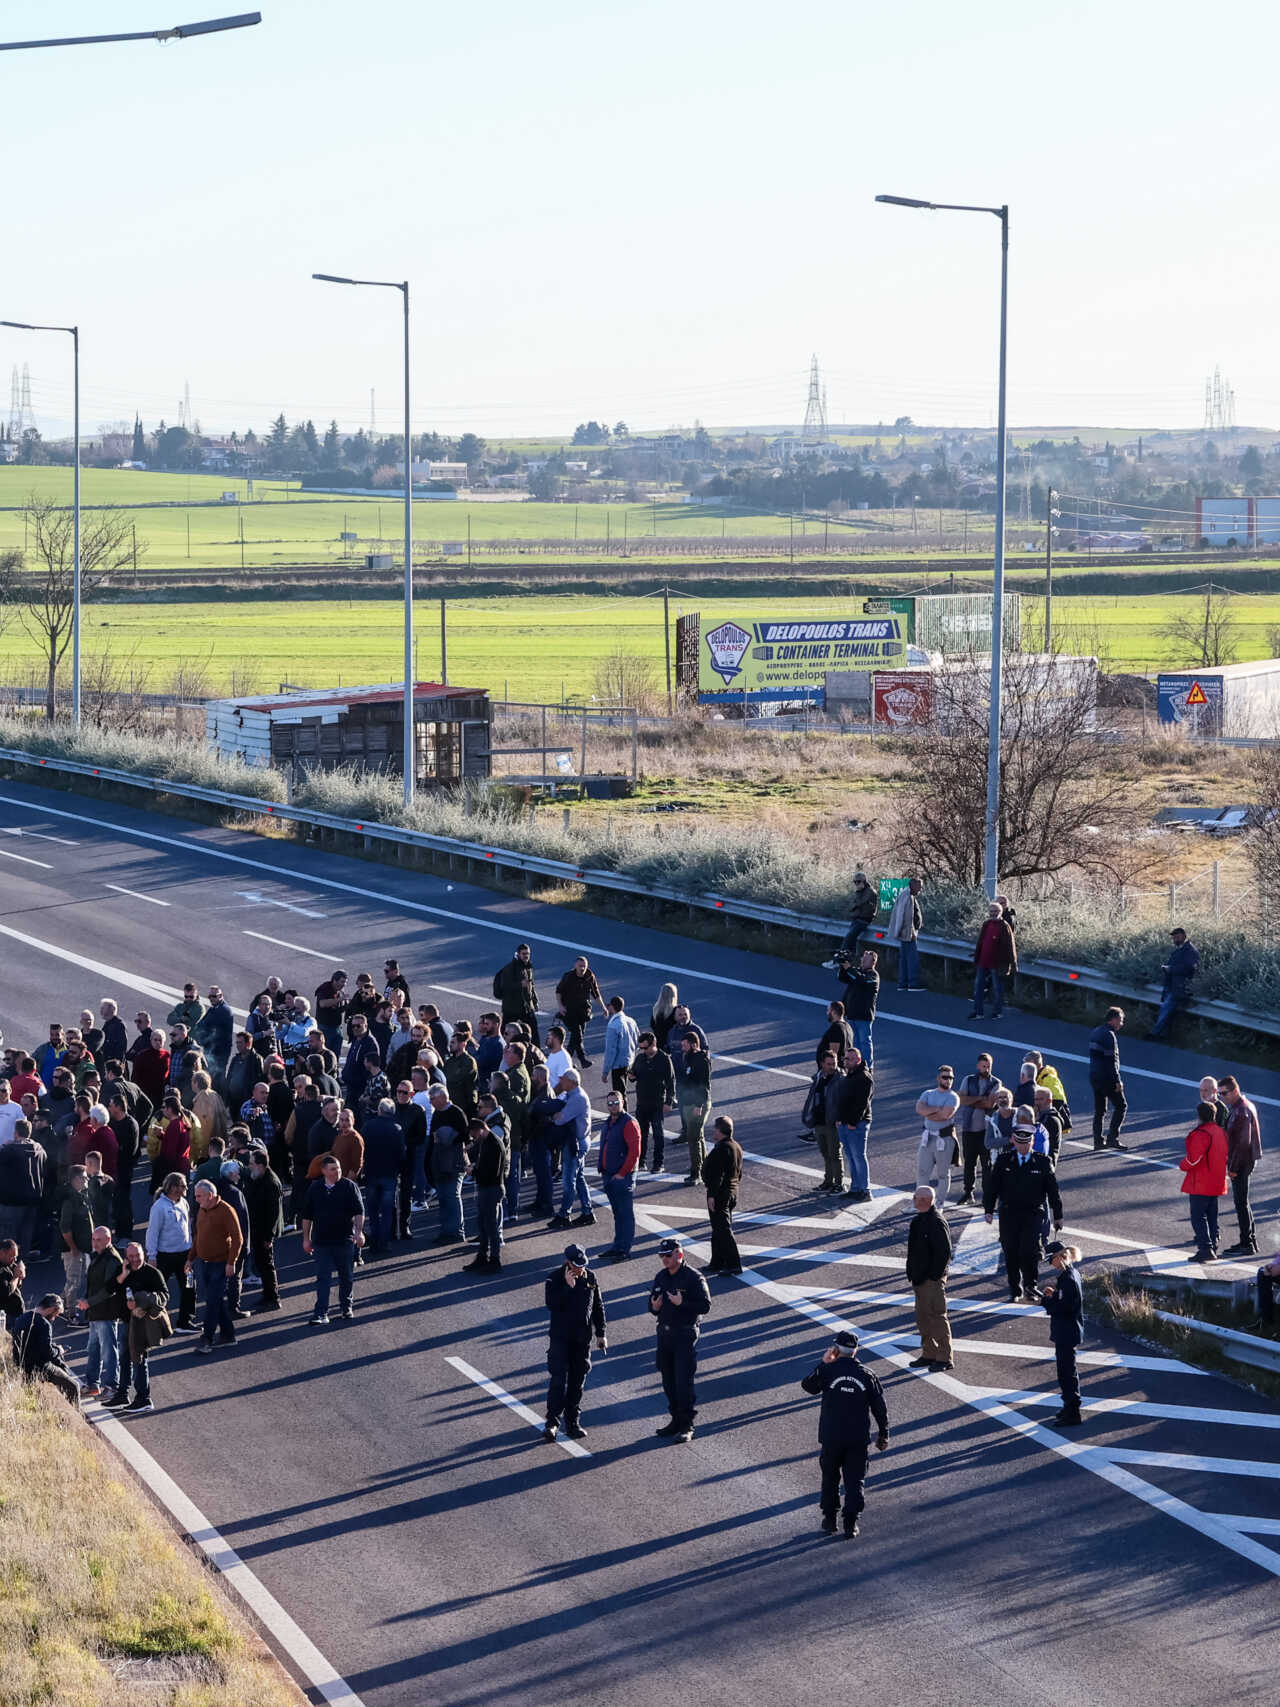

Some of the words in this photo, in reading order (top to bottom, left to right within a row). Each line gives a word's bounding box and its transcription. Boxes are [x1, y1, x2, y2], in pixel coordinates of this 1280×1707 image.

[711, 626, 746, 645] DELOPOULOS
[766, 624, 846, 640] DELOPOULOS
[847, 622, 889, 638] TRANS
[714, 644, 745, 652] TRANS
[776, 644, 832, 660] CONTAINER
[833, 643, 880, 658] TERMINAL
